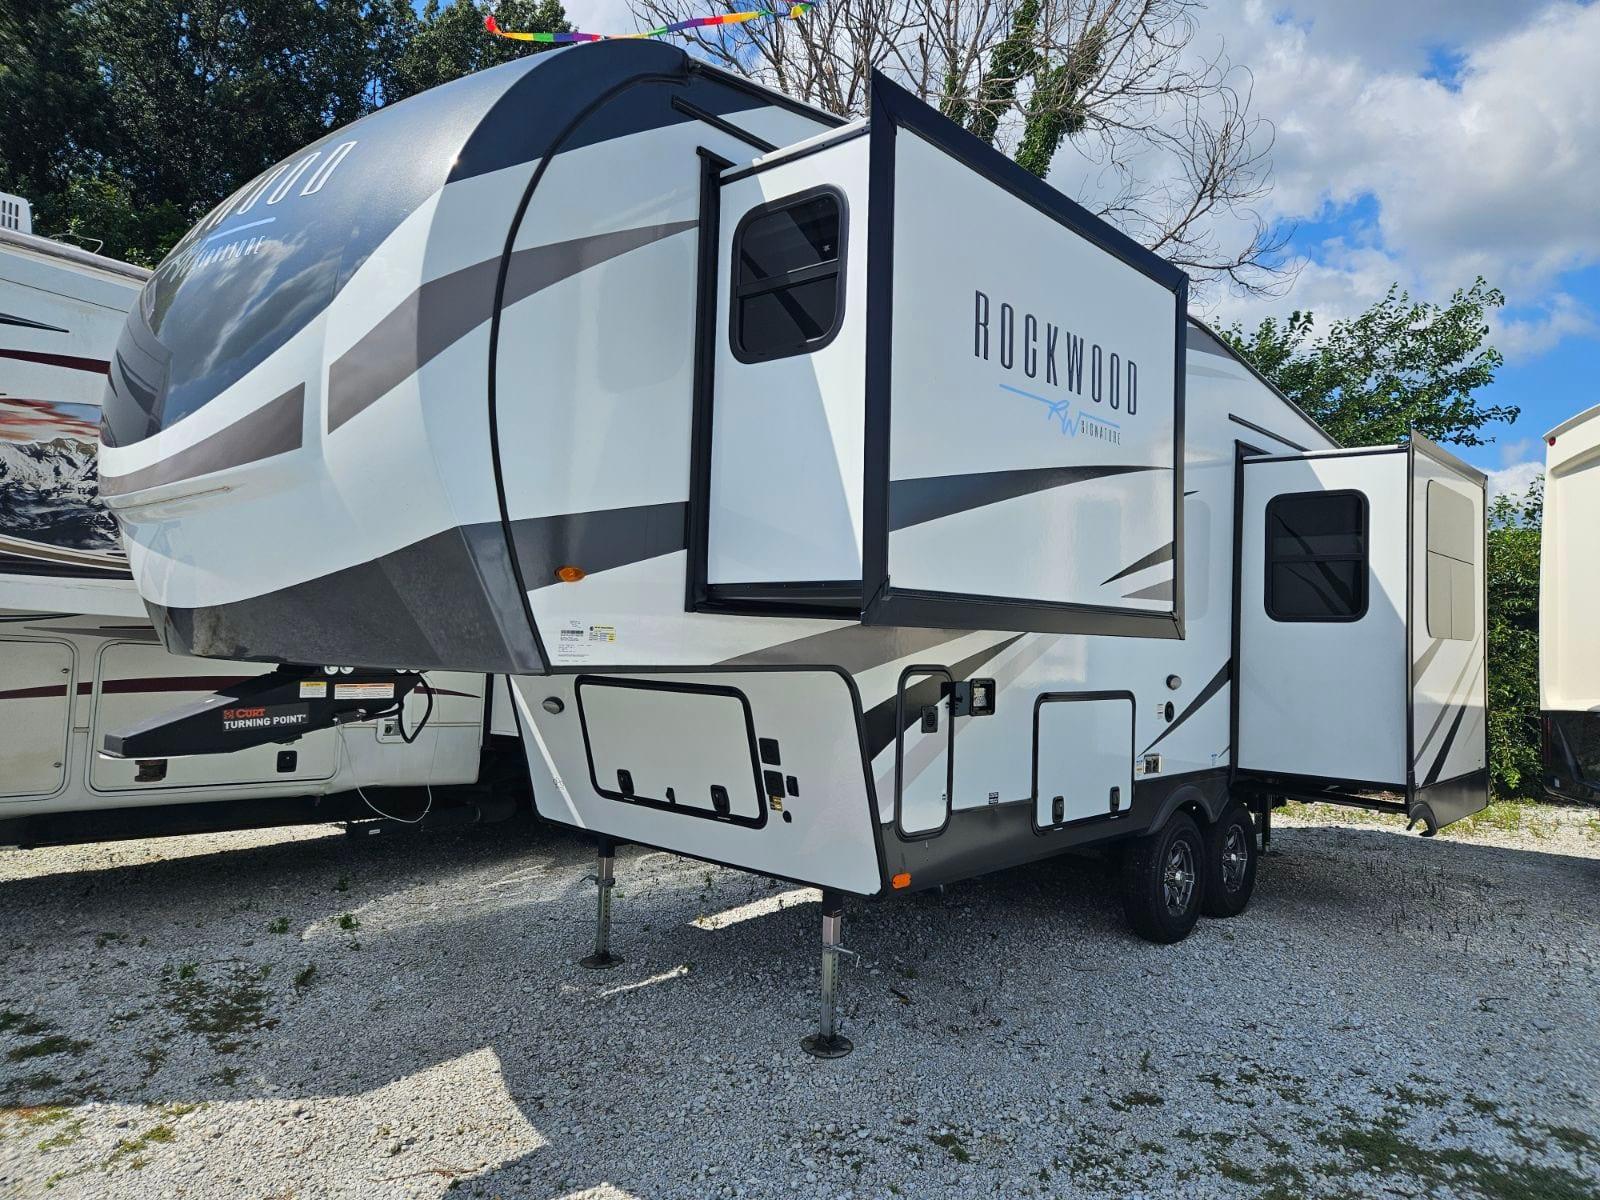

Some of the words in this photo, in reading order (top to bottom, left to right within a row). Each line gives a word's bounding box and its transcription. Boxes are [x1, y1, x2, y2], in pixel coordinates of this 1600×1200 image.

[974, 289, 1138, 416] ROCKWOOD
[1080, 419, 1121, 447] SIGNATURE
[223, 717, 271, 730] TURNING
